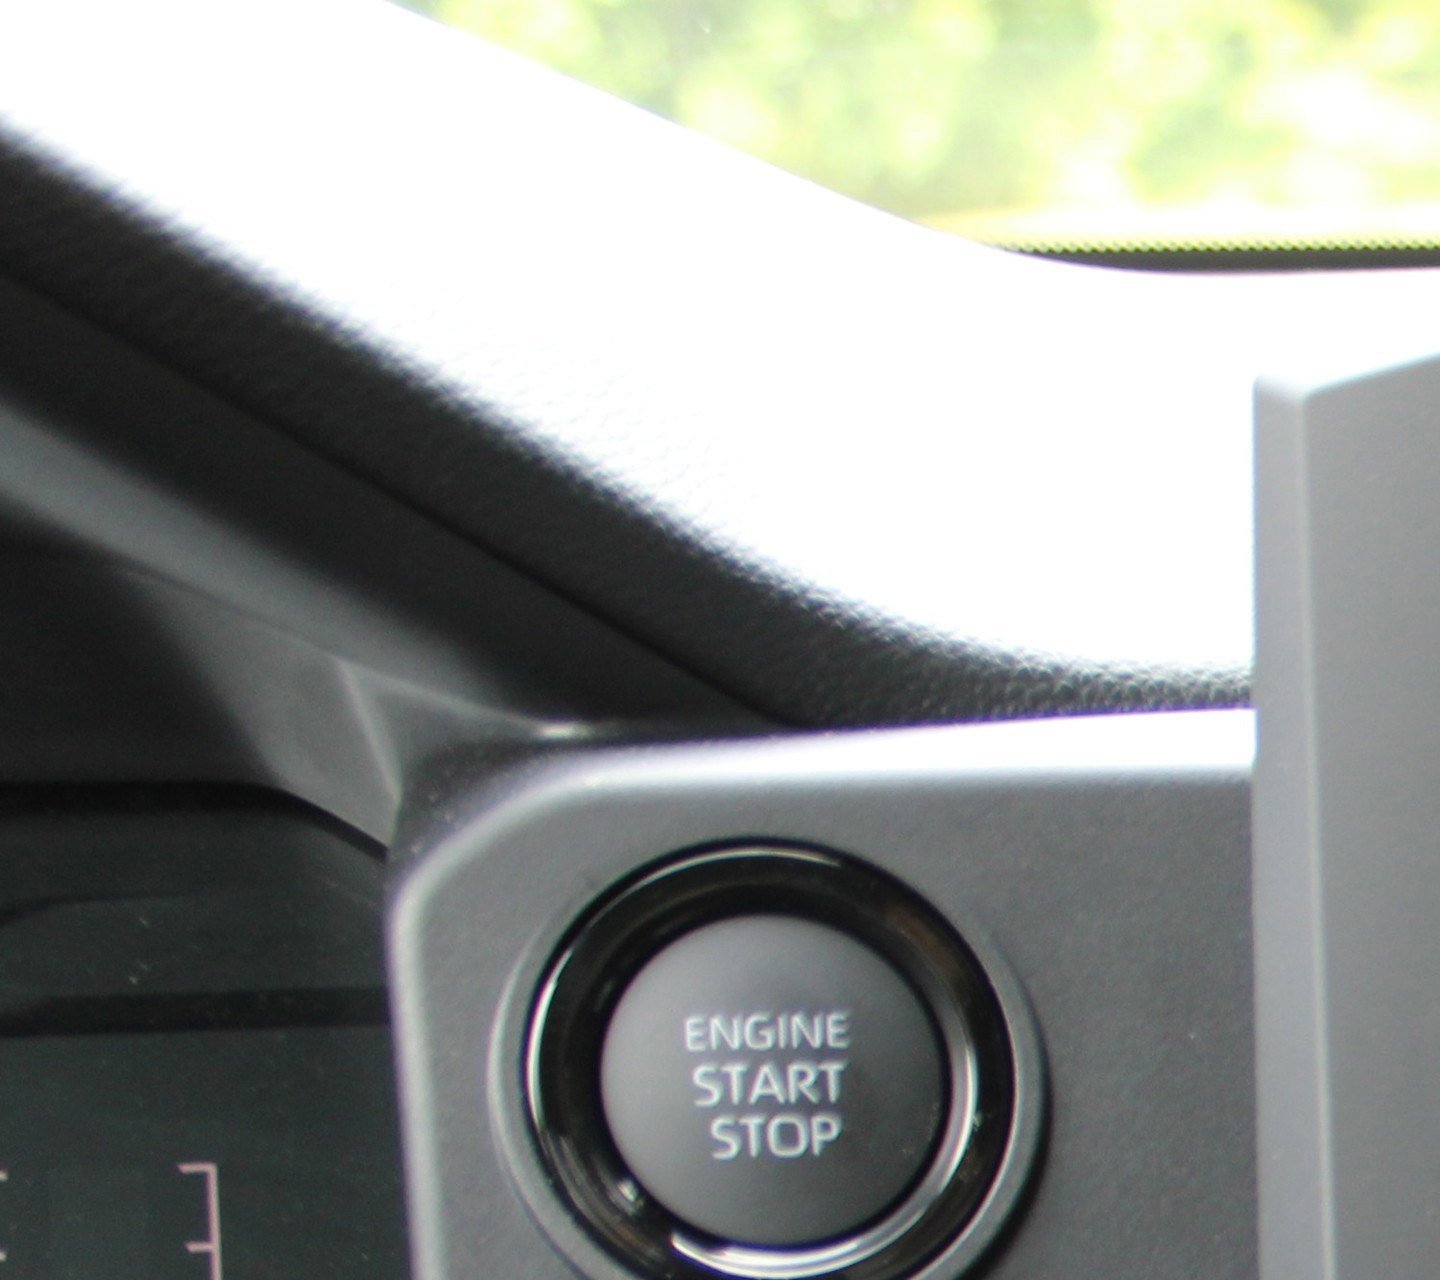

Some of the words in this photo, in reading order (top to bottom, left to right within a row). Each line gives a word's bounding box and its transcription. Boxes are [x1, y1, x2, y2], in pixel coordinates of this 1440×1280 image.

[683, 1012, 851, 1053] ENGINE
[691, 1060, 848, 1109] START
[710, 1114, 841, 1160] STOP
